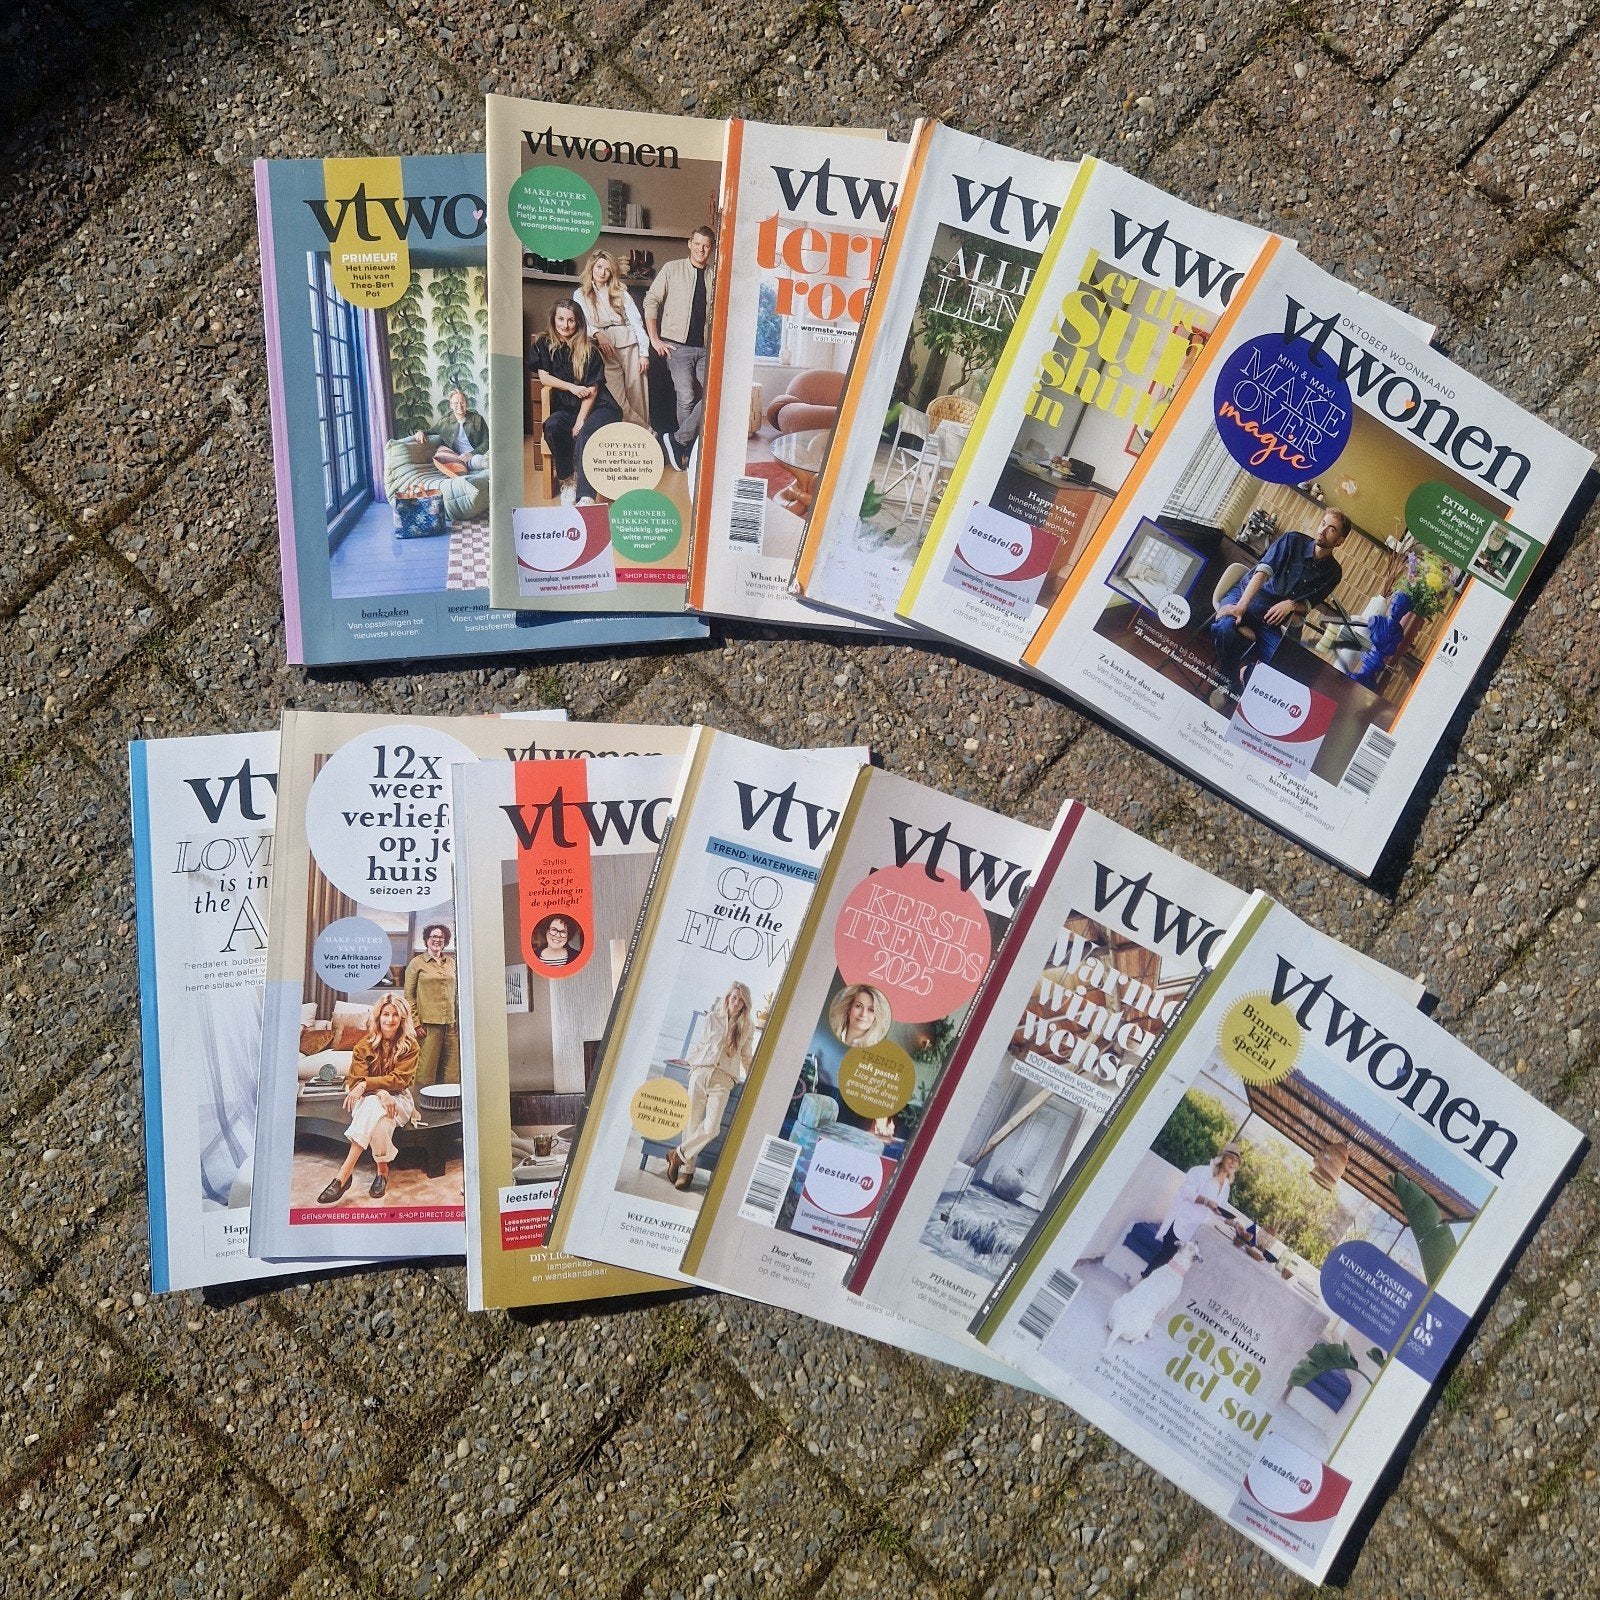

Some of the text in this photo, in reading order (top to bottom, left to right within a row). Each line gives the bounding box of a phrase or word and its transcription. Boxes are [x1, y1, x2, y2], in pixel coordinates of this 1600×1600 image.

[521, 126, 681, 169] vtwonen
[523, 187, 586, 200] MAKE-OVERS
[770, 158, 898, 223] vtw
[303, 183, 487, 242] vtwo
[518, 203, 592, 218] Kelly, Marianne,
[558, 199, 572, 207] TV
[520, 221, 579, 233] woonproblemen
[341, 253, 397, 263] PRIMEUR
[353, 272, 371, 280] huis
[1079, 247, 1207, 334] Let the
[801, 325, 834, 334] warmste
[1342, 317, 1455, 400] OKTOBER WOONMAAND
[1277, 354, 1336, 398] MINI MAXI
[1240, 347, 1346, 438] MAKE
[1283, 294, 1531, 501] vtwonen
[1024, 382, 1063, 427] in
[1232, 380, 1323, 462] OVER
[1219, 401, 1312, 469] magic
[1008, 494, 1052, 516] binnenkijken
[1028, 491, 1078, 518] Happy vibes:
[1443, 495, 1485, 527] EXTRA DIK
[521, 529, 578, 540] leestafel.nl
[1039, 517, 1071, 536] vtwonen-
[1419, 517, 1453, 542] ontworpen
[1438, 517, 1474, 544] must-haves
[1450, 514, 1479, 535] pagina's
[969, 526, 1022, 555] leestafel.nl
[1438, 540, 1465, 561] vtwonen
[539, 582, 598, 592] www.leesmap.nl
[751, 571, 772, 582] What
[961, 580, 1015, 608] www.leesmap.nl
[347, 619, 409, 630] Van opstellingen
[361, 608, 409, 618] bankzaken
[354, 628, 419, 639] nieuwste kleuren
[1437, 653, 1454, 668] 2025
[1442, 642, 1458, 657] 10
[1251, 684, 1301, 717] leestafel.nl
[373, 745, 443, 780] 12x
[1241, 738, 1293, 770] www.leesmap.nl
[369, 783, 442, 799] weer
[1268, 775, 1319, 811] binnenkijken
[1288, 777, 1319, 799] pagina's
[341, 803, 451, 829] verlief
[379, 836, 416, 861] op
[713, 843, 749, 860] TREND:
[366, 856, 437, 882] huis
[536, 867, 575, 875] Marianne:
[543, 858, 567, 866] Stylist
[220, 871, 268, 892] is in
[370, 887, 431, 895] seizoen 23
[552, 877, 565, 885] zet
[717, 867, 783, 910] GO
[195, 891, 230, 913] the
[529, 889, 572, 898] verlichting
[531, 899, 540, 907] de
[714, 904, 783, 932] with the
[863, 883, 981, 948] KERST
[325, 936, 383, 944] MAKE-OVERS
[843, 907, 984, 982] TRENDS
[345, 971, 360, 979] chic
[869, 950, 935, 995] 2025
[1242, 1003, 1292, 1048] Binnen-
[1247, 1028, 1273, 1055] kijk
[1232, 1036, 1276, 1071] special
[1270, 953, 1518, 1180] vtwonen
[815, 1164, 872, 1188] leestafel.nl
[352, 1212, 387, 1220] GERAAKT?
[621, 1223, 670, 1240] Schitterende
[646, 1241, 659, 1249] het
[771, 1245, 812, 1266] Dear Santa
[530, 1254, 547, 1262] DIY
[547, 1261, 592, 1271] lampenkap
[774, 1260, 815, 1278] mag direct
[544, 1268, 608, 1281] wandkandelaar
[782, 1274, 811, 1289] wishlist
[930, 1273, 977, 1299] PYJAMAPARTY
[1338, 1254, 1408, 1309] KINDERKAMERS
[1375, 1268, 1413, 1301] DOSSIER
[1207, 1298, 1261, 1341] 132 PAGINA'S
[1186, 1299, 1267, 1365] Zomerse huizen
[1413, 1326, 1434, 1347] 08
[1168, 1314, 1261, 1396] casa
[1407, 1340, 1424, 1355] 2025
[1165, 1353, 1272, 1441] del sol
[1259, 1456, 1310, 1492] leestafel.nl
[1246, 1516, 1299, 1551] www.leesmap.nl
